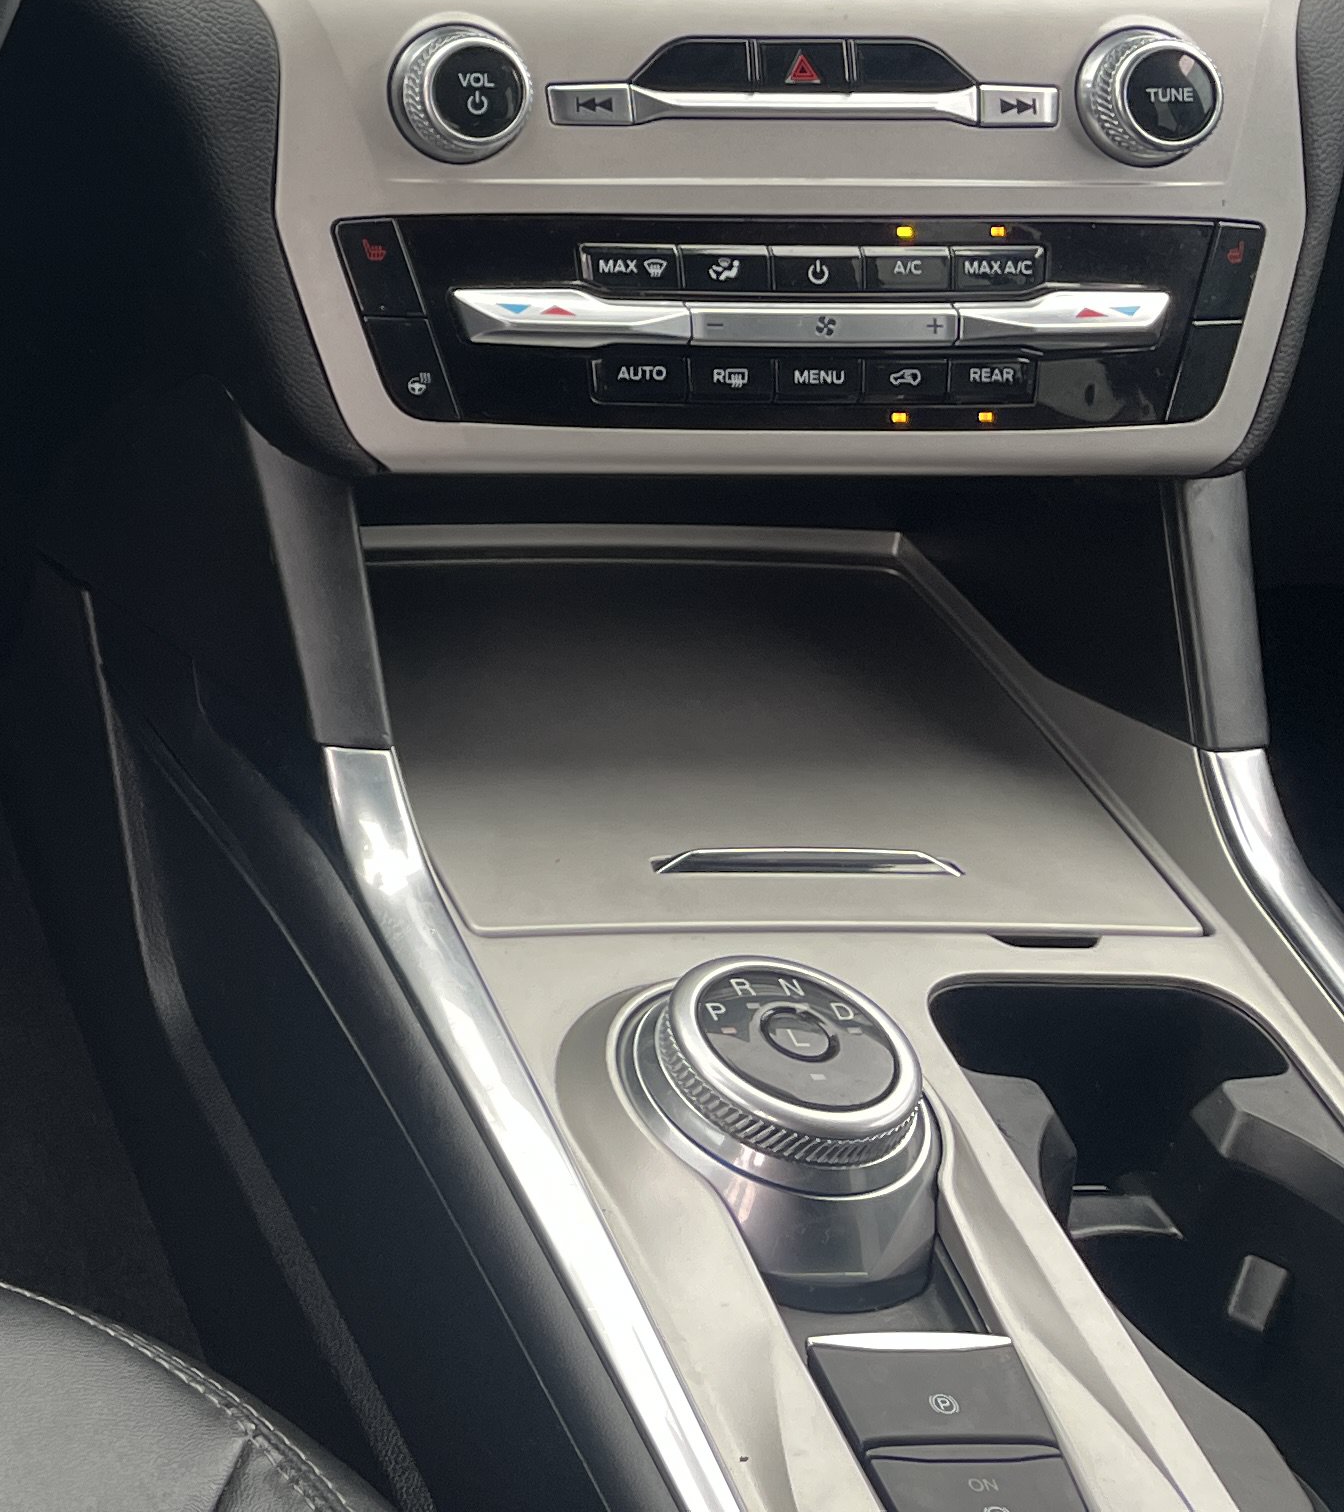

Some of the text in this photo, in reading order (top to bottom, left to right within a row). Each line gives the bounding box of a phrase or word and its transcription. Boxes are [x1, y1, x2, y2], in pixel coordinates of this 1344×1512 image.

[457, 71, 496, 88] VOL
[1146, 86, 1196, 104] TUNE
[598, 258, 638, 275] MAX
[892, 259, 924, 277] A/C
[963, 259, 1034, 278] MAX A/C
[616, 365, 667, 382] AUTO
[793, 367, 846, 386] MENU
[968, 367, 1015, 384] REAR
[729, 977, 758, 997] R
[777, 977, 806, 997] N
[704, 1002, 727, 1022] P
[829, 1001, 856, 1021] D
[785, 1028, 812, 1048] L
[967, 1477, 1000, 1493] ON
